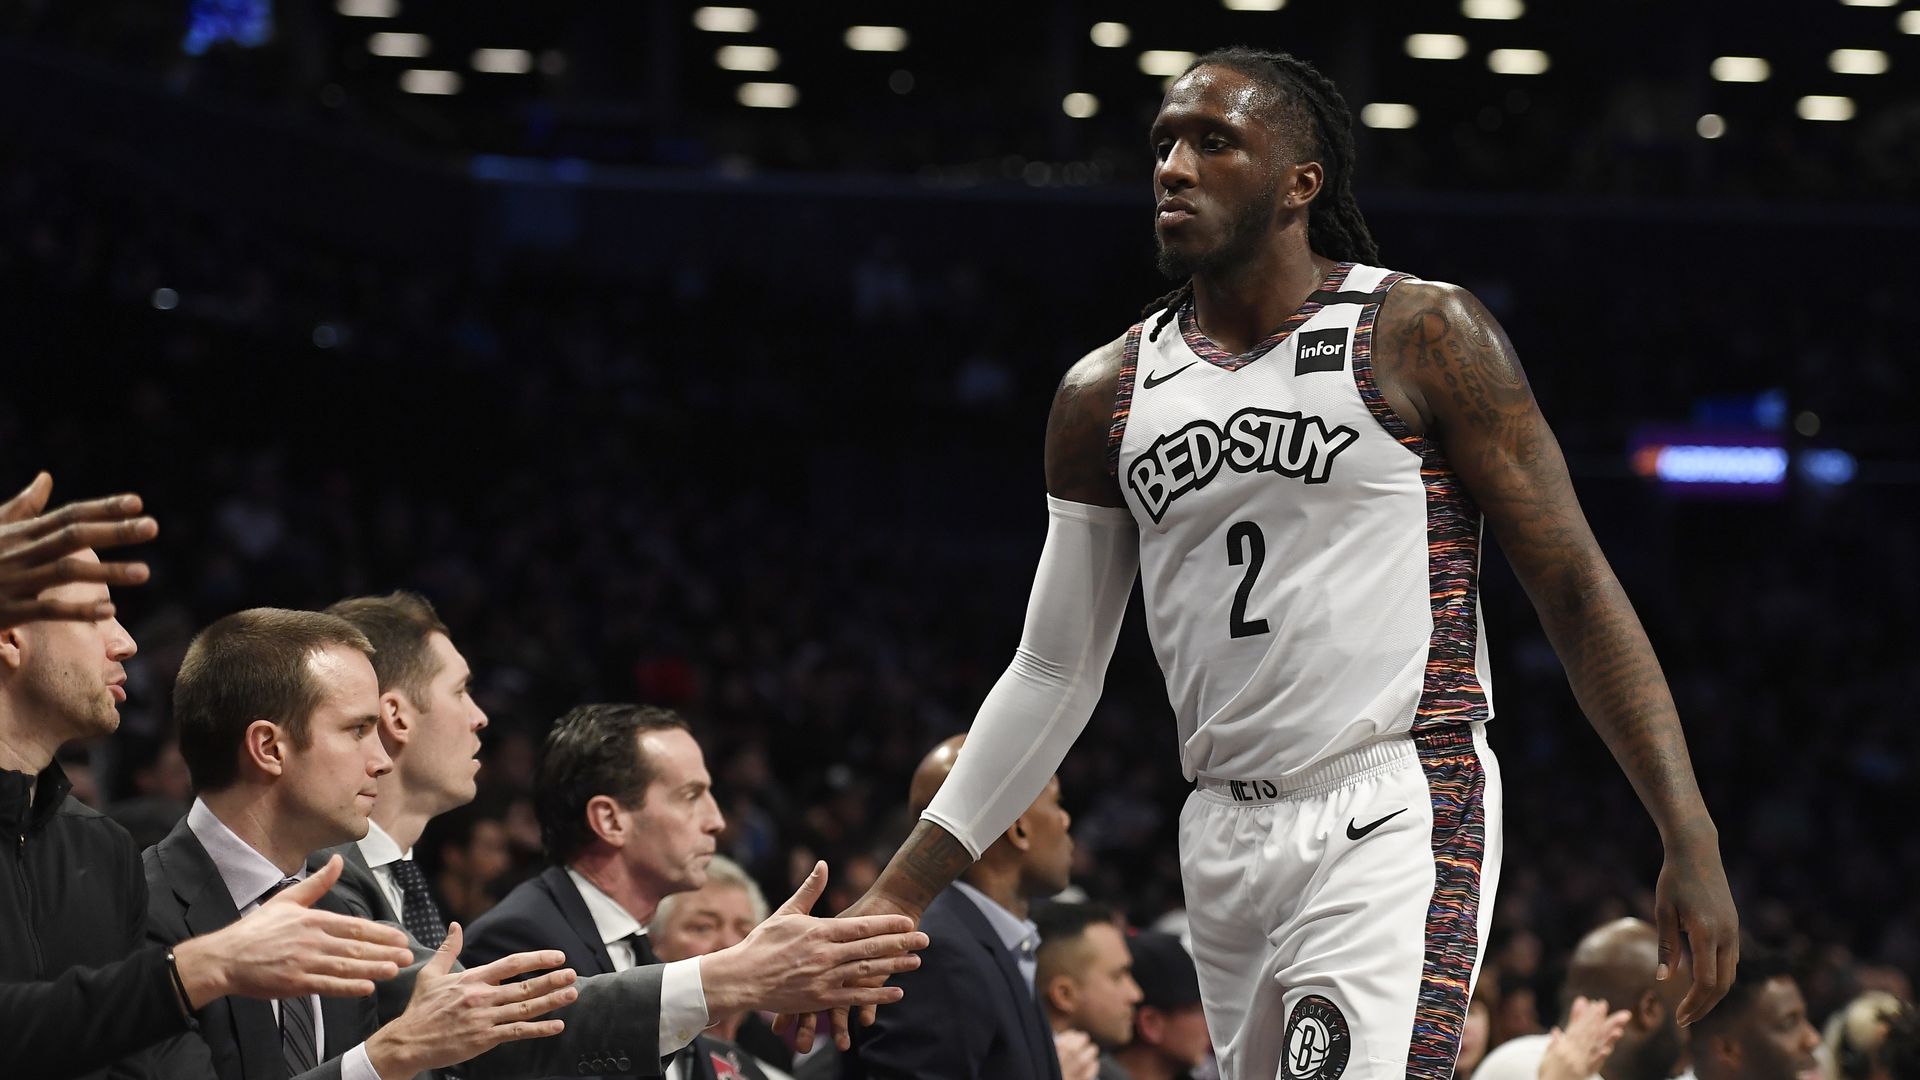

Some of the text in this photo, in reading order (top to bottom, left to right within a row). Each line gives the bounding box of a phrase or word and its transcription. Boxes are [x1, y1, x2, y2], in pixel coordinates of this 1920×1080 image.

[1300, 340, 1344, 359] infor
[1128, 407, 1359, 524] BED-STUY
[1226, 521, 1270, 638] 2
[1296, 1024, 1316, 1071] B
